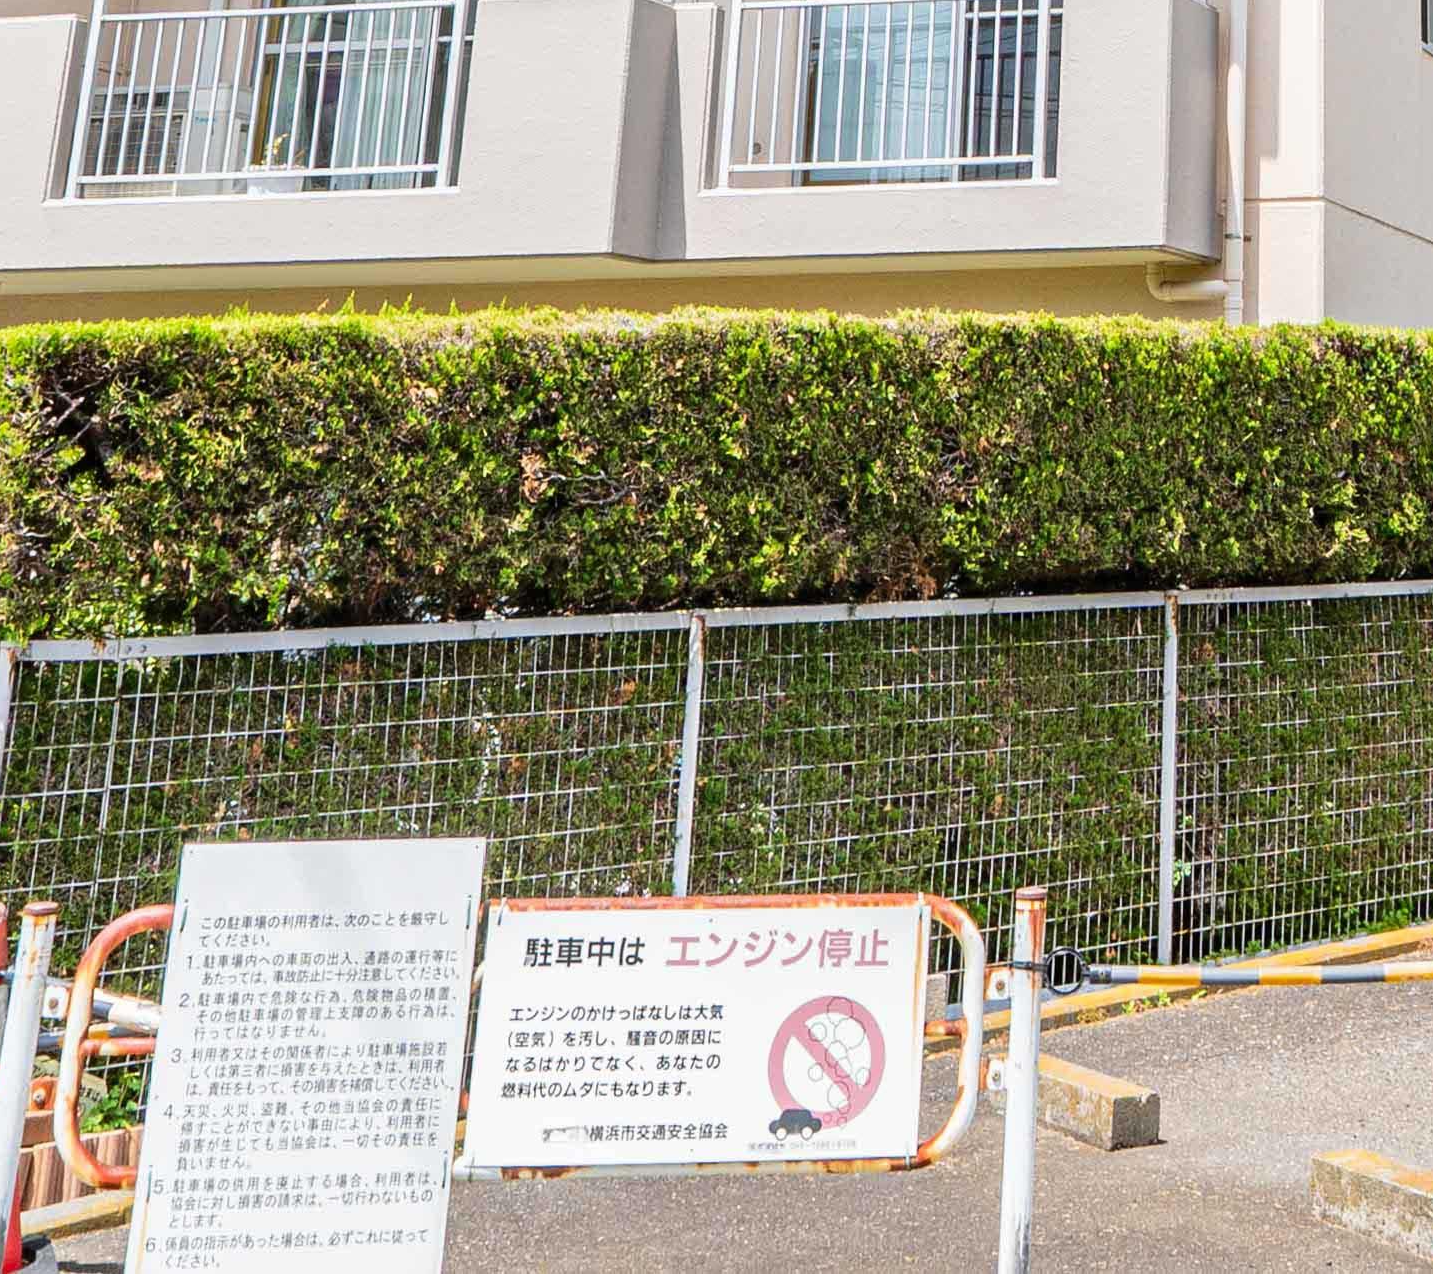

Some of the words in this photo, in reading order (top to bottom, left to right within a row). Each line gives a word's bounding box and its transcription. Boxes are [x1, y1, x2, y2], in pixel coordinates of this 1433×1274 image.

[200, 911, 450, 930] この駐車場の利用者は、次のことを厳守し
[198, 934, 271, 948] てください。
[523, 937, 646, 967] 駐車中は
[664, 928, 890, 968] エンジン停止
[201, 966, 461, 986] あたっては、事故防止に十分注意してください。
[195, 1004, 455, 1023] その他駐車場の管理上支障のある行為は、
[509, 1004, 724, 1022] エンジンのかけっぱなしは大気
[192, 1025, 327, 1041] 行ってはなりません。
[507, 1028, 722, 1047] (空気)を汚し、騒音の原因に
[189, 1059, 447, 1080] しくは第三者に損害を与えたときは、利用者
[504, 1054, 722, 1073] なるばかりでなく、あなたの
[500, 1080, 693, 1099] 燃料代のムダにもなります。
[180, 1115, 441, 1136] 帰すことができない事由により、利用者に
[589, 1122, 728, 1142] 横浜市交通安全協会
[177, 1132, 439, 1153] 損害が生じても当協会は、一切その責任を
[175, 1155, 252, 1172] 負いません。
[170, 1190, 434, 1211] 協会に対し損害の請求は、一切行わないもの
[168, 1213, 223, 1229] とします。
[164, 1253, 220, 1268] ください。
